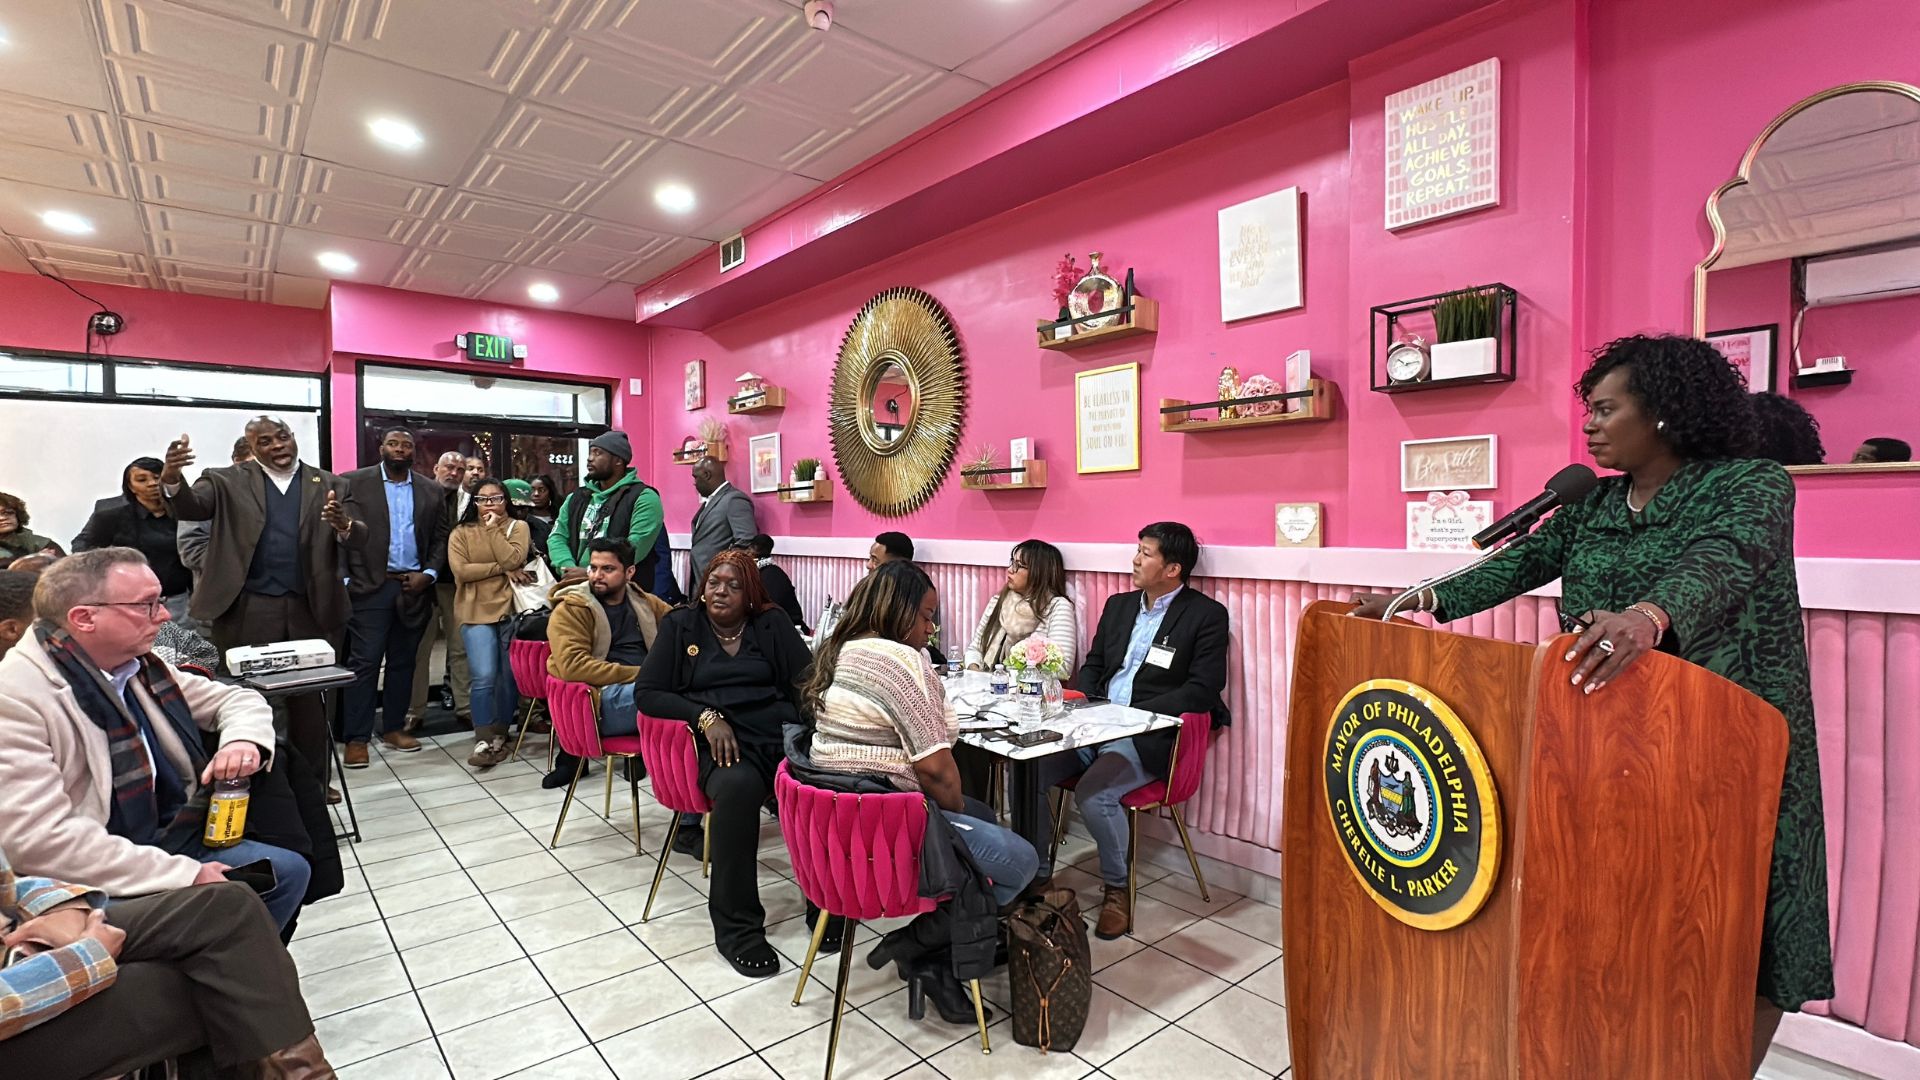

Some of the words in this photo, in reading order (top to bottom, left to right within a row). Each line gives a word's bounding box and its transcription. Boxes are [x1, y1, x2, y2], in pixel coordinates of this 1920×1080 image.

[1400, 97, 1442, 124] WAKE
[1406, 106, 1469, 139] HUSTLE
[1404, 137, 1432, 157] ALL
[1438, 123, 1470, 145] DAY.
[1405, 140, 1472, 174] ACHIEVE
[1411, 158, 1471, 187] GOALS.
[1406, 175, 1469, 208] REPEAT.
[475, 334, 511, 359] EXIT
[1414, 454, 1438, 480] Be
[1443, 446, 1481, 473] Still
[1426, 535, 1469, 543] superpower?
[1331, 712, 1361, 774] MAYOR
[1363, 701, 1382, 721] OF
[1387, 701, 1469, 833] PHILADELPHIA
[1336, 799, 1386, 883] CHERELLE
[1391, 873, 1403, 894] L.
[1408, 858, 1460, 898] PARKER
